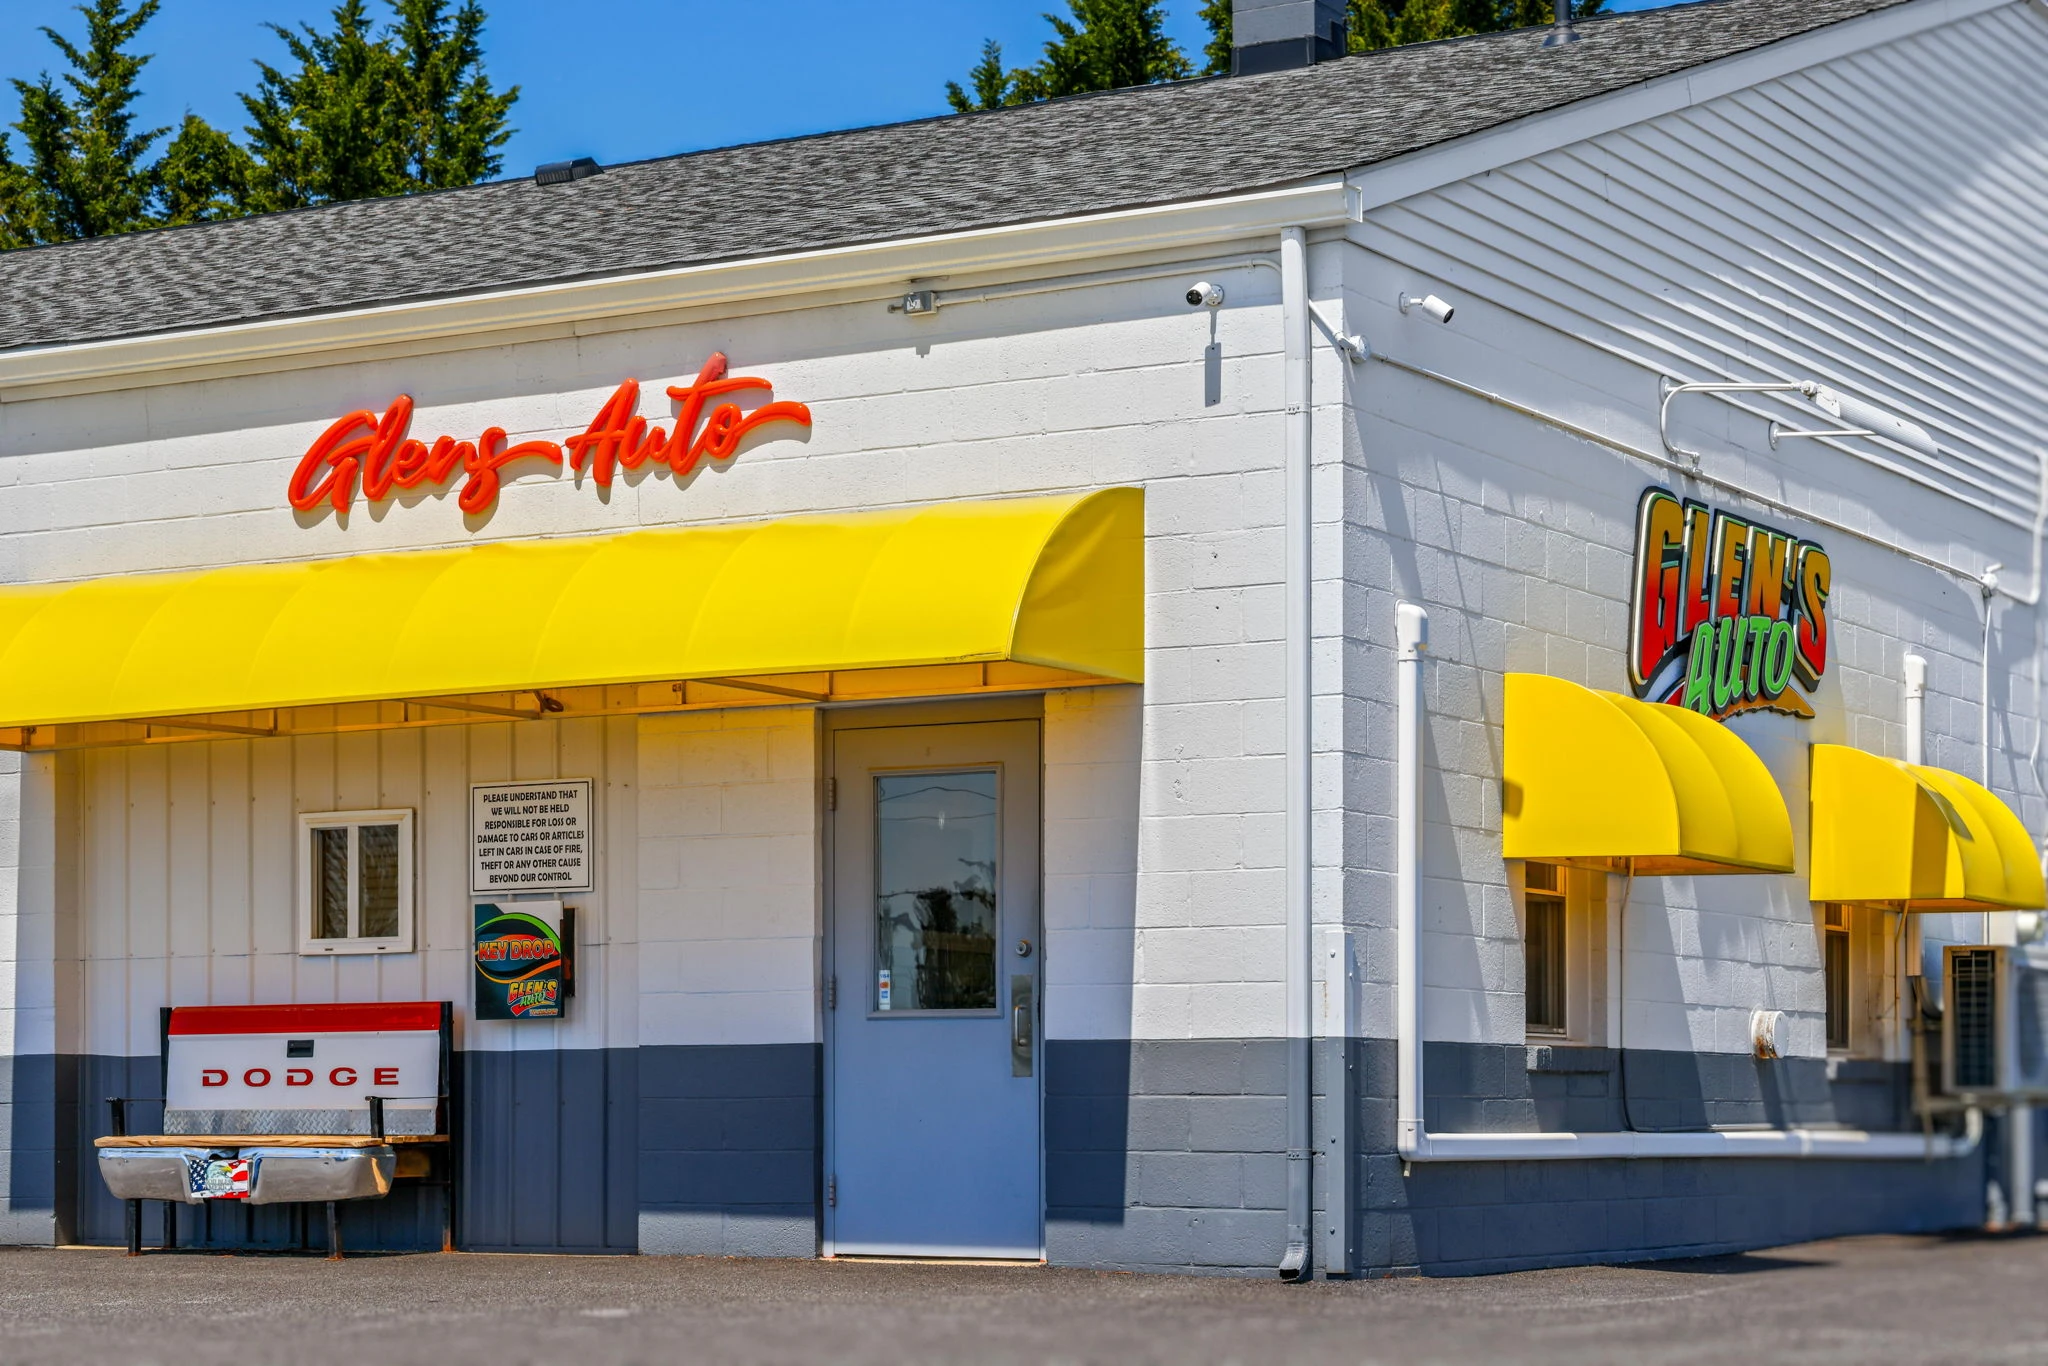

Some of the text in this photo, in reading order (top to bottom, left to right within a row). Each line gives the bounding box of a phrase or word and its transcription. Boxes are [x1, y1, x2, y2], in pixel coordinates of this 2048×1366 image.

[288, 351, 812, 514] Glens Auto
[1628, 485, 1832, 700] GLEN'S
[1681, 614, 1797, 717] AUTO
[484, 789, 578, 803] PLEASE UNDERSTAND THAT
[491, 803, 570, 816] WE WILL NOT BE HELD
[485, 817, 577, 829] RESPONSIBLE FOR LOSS OR
[477, 830, 584, 843] DAMAGE TO CARS OR ARTICLES
[479, 844, 583, 857] LEFT IN CARS IN CASE OF FIRE,
[481, 857, 581, 870] THEFT OR ANY OTHER CAUSE
[490, 871, 572, 883] BEYOND OUR CONTROL
[478, 938, 555, 961] KEY DROP
[508, 979, 558, 1005] GLEN'S
[520, 992, 545, 1006] AUTO
[202, 1067, 399, 1087] DODGE
